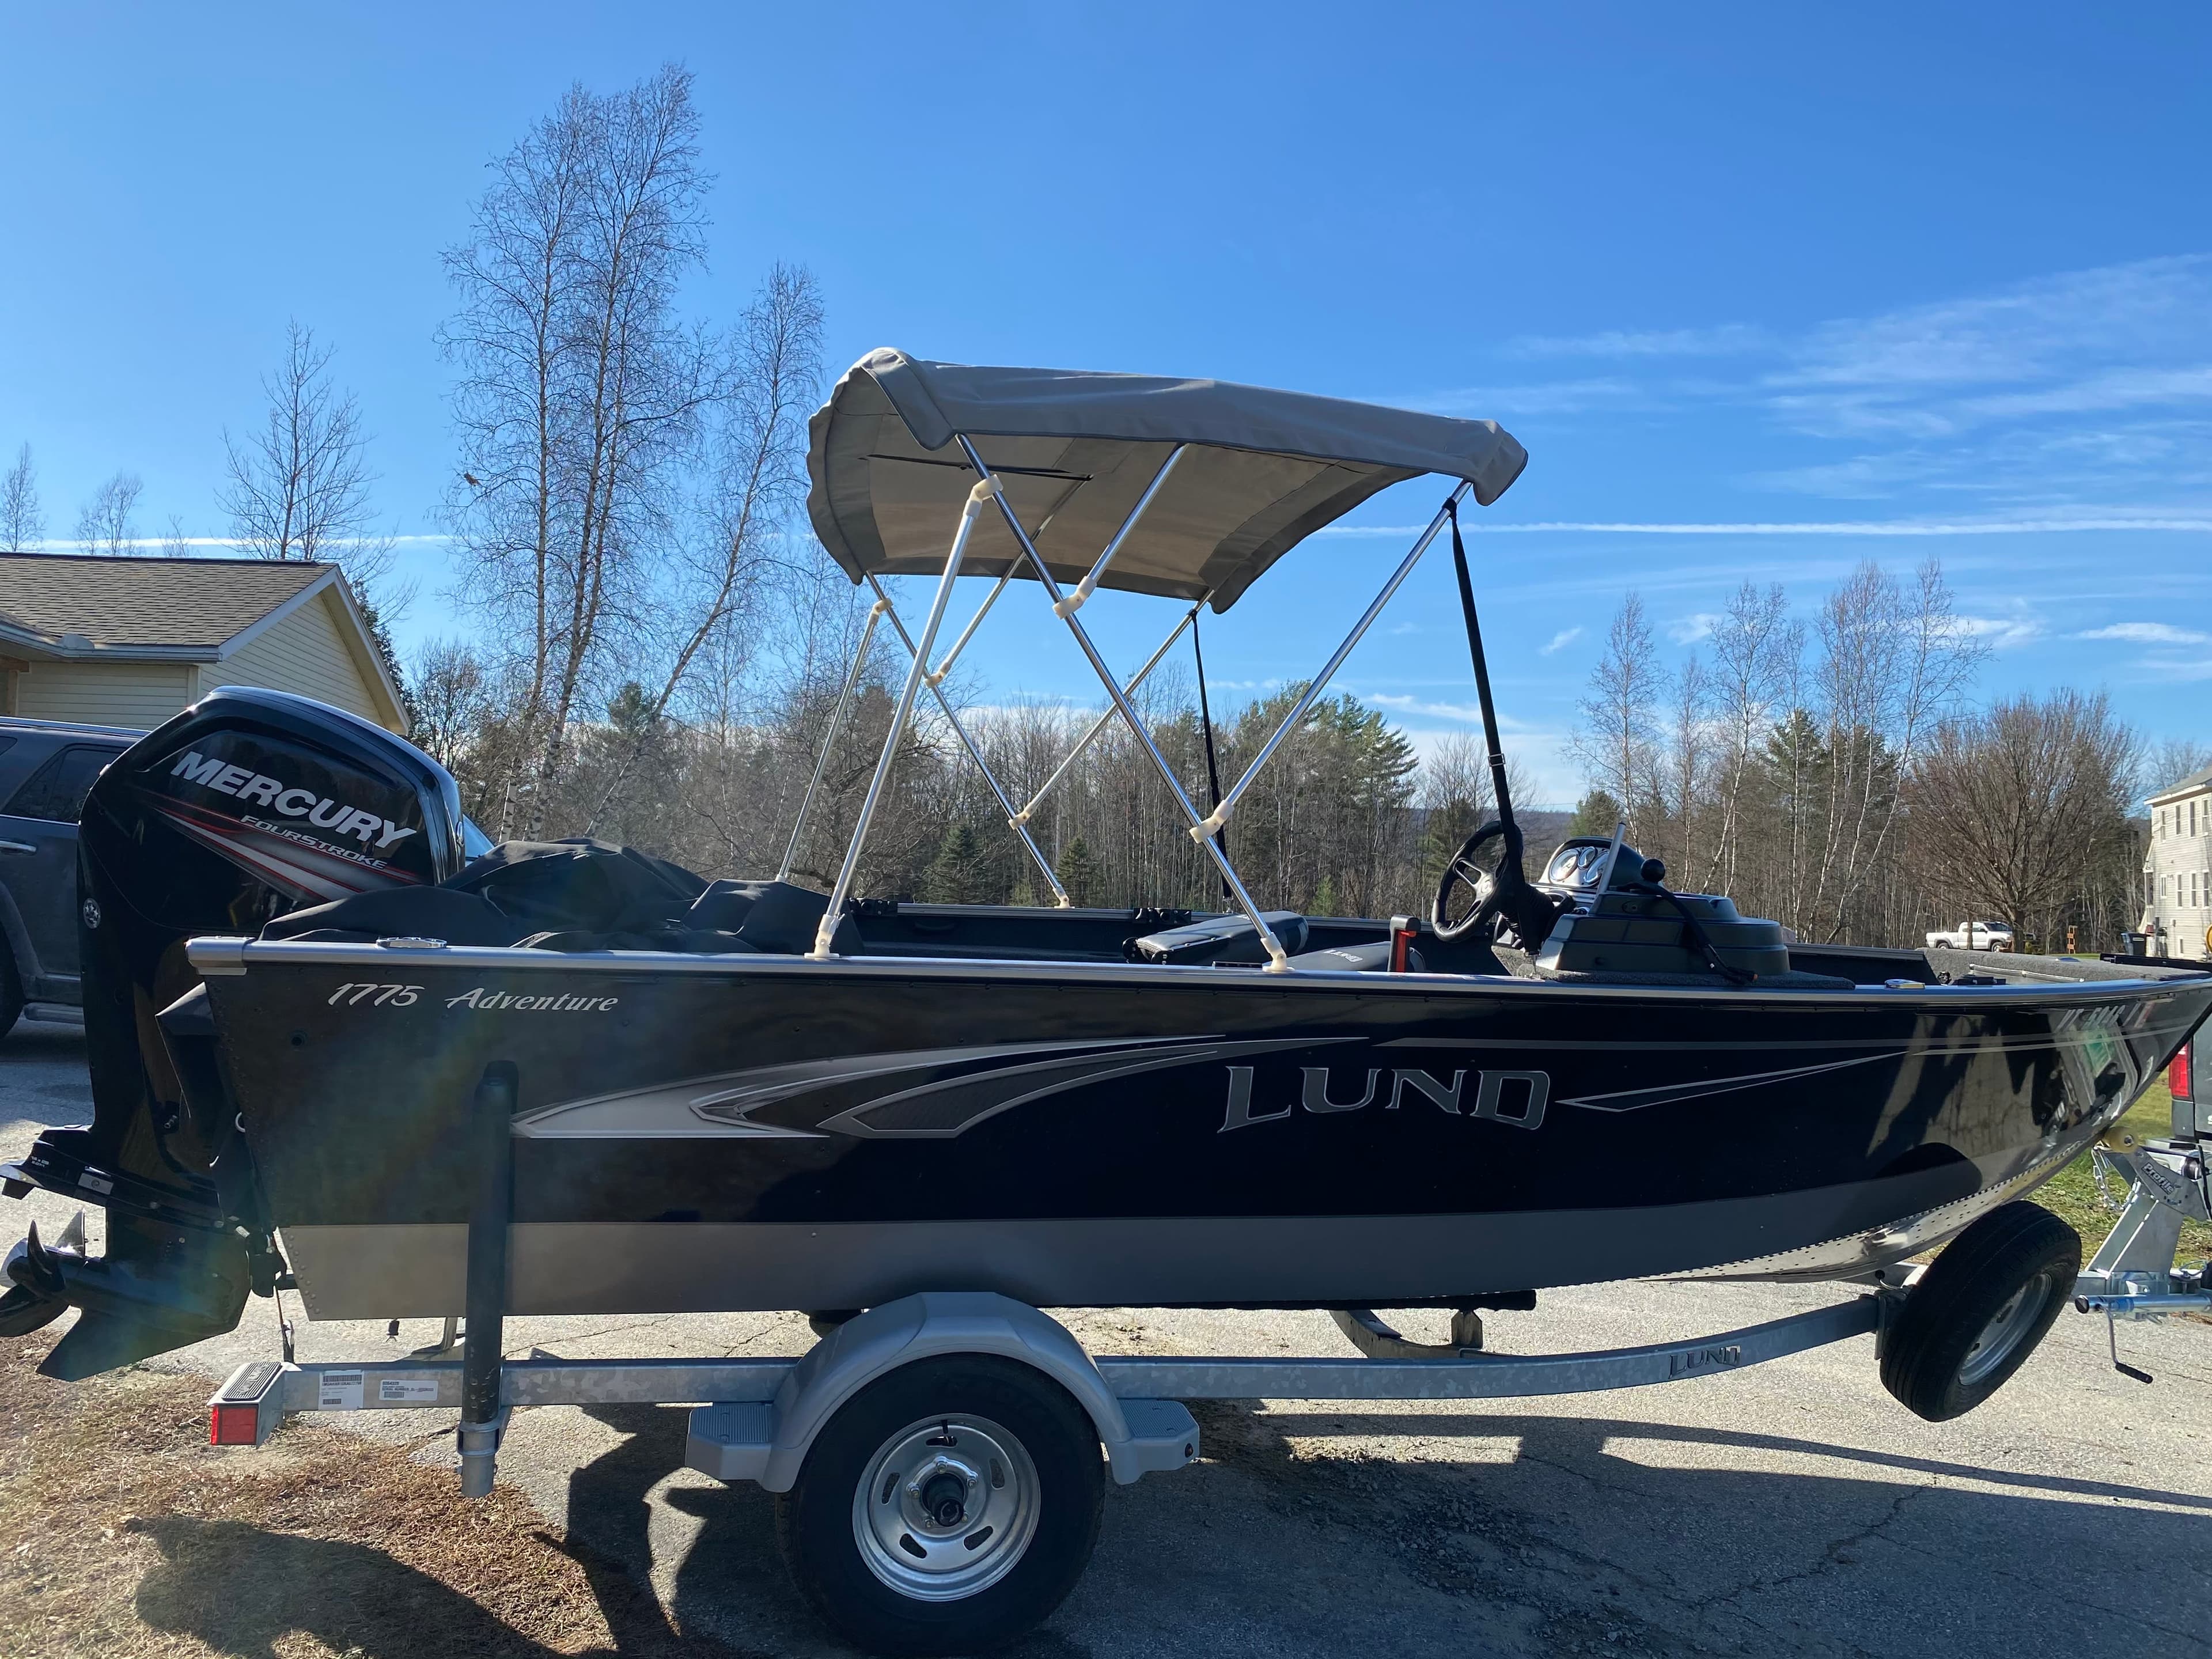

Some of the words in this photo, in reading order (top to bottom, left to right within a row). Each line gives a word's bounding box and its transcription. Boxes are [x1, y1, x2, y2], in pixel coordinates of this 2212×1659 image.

[170, 751, 417, 849] MERCURY
[240, 815, 388, 869] FOURSTROKE
[328, 983, 425, 1007] 1775
[444, 987, 619, 1012] Adventure
[1217, 1066, 1550, 1134] LUND
[2141, 1162, 2175, 1195] Profile
[1668, 1344, 1741, 1380] LUND
